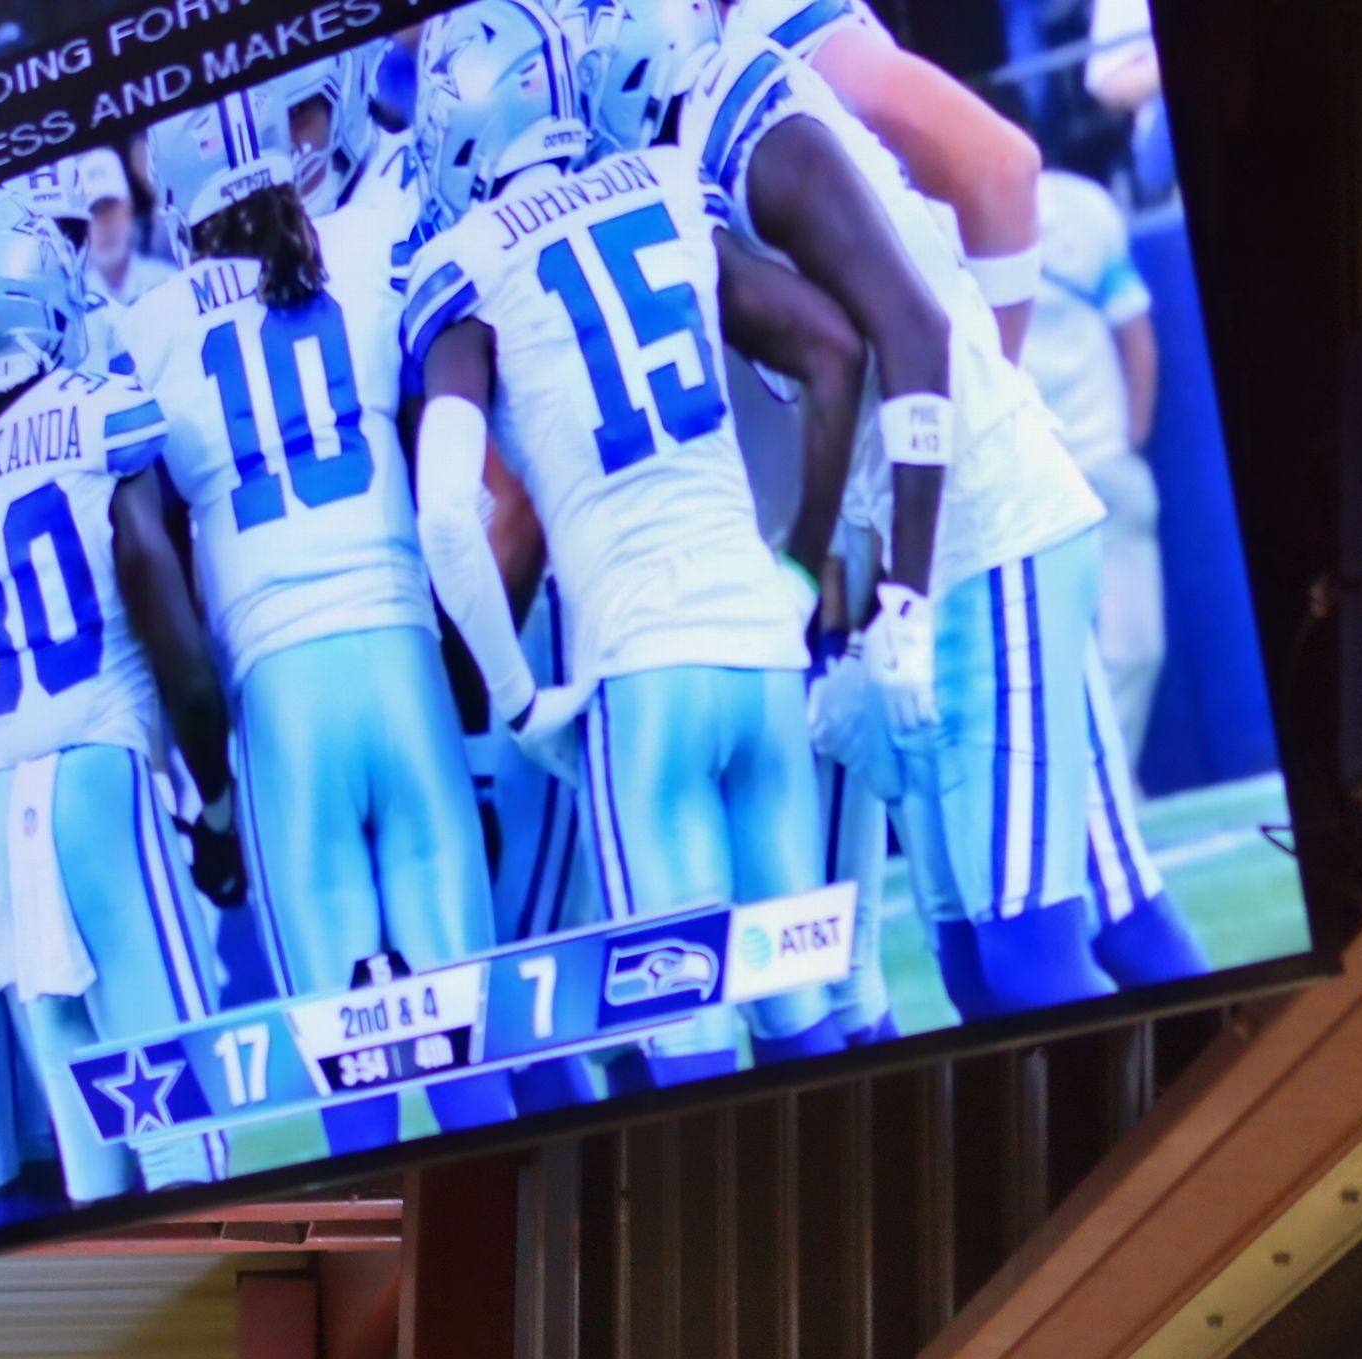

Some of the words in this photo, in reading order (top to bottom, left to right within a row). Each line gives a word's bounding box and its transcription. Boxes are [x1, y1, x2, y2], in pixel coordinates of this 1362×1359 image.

[90, 64, 192, 129] AND
[203, 0, 381, 84] MAKES
[495, 154, 661, 250] JOHNSON
[189, 263, 261, 318] MIL
[537, 201, 728, 476] 15
[200, 282, 375, 536] 10
[779, 914, 842, 958] AT&T
[339, 997, 389, 1039] 2nd
[423, 986, 439, 1020] 4
[520, 954, 560, 1039] 7
[212, 1025, 269, 1106] 17
